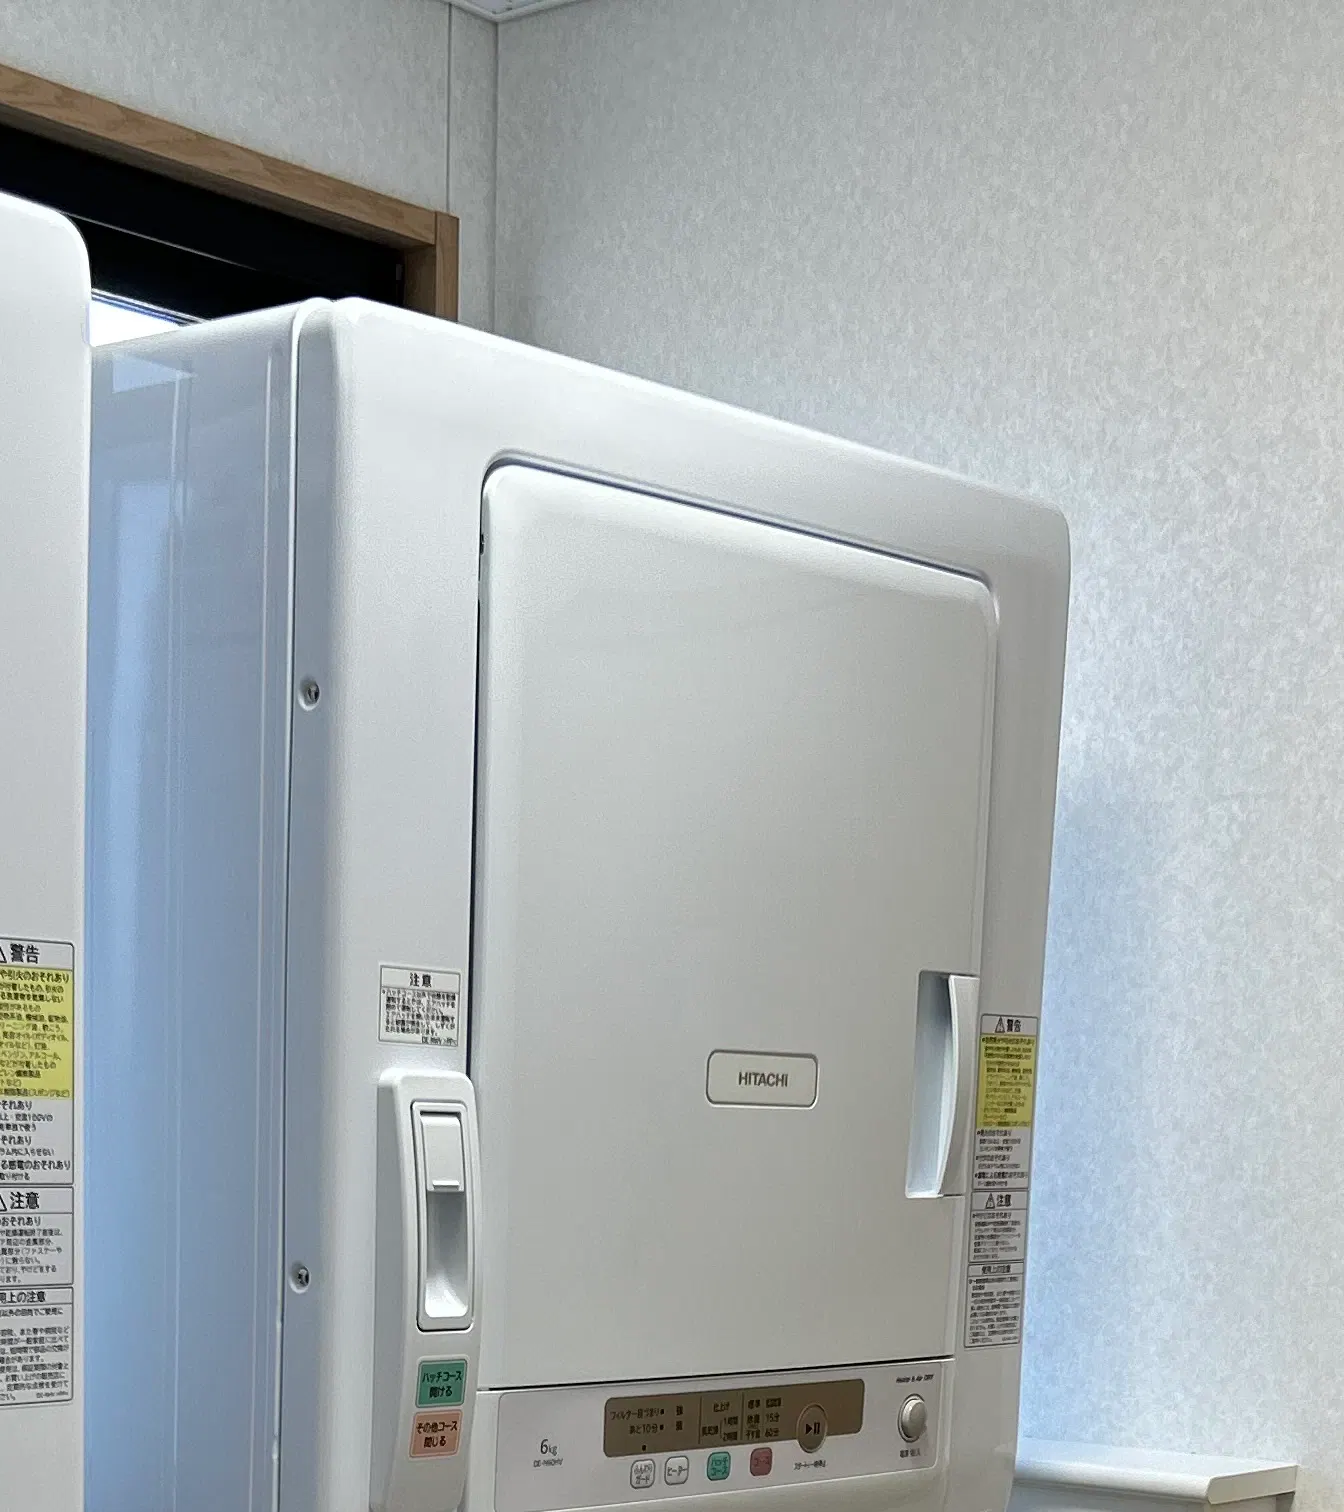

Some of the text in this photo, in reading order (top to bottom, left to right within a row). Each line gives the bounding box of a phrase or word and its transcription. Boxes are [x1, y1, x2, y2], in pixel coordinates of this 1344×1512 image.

[10, 943, 40, 964] 警告
[738, 1072, 789, 1087] HITACHI
[10, 1191, 40, 1210] 注意
[422, 1370, 463, 1383] ハッチコース
